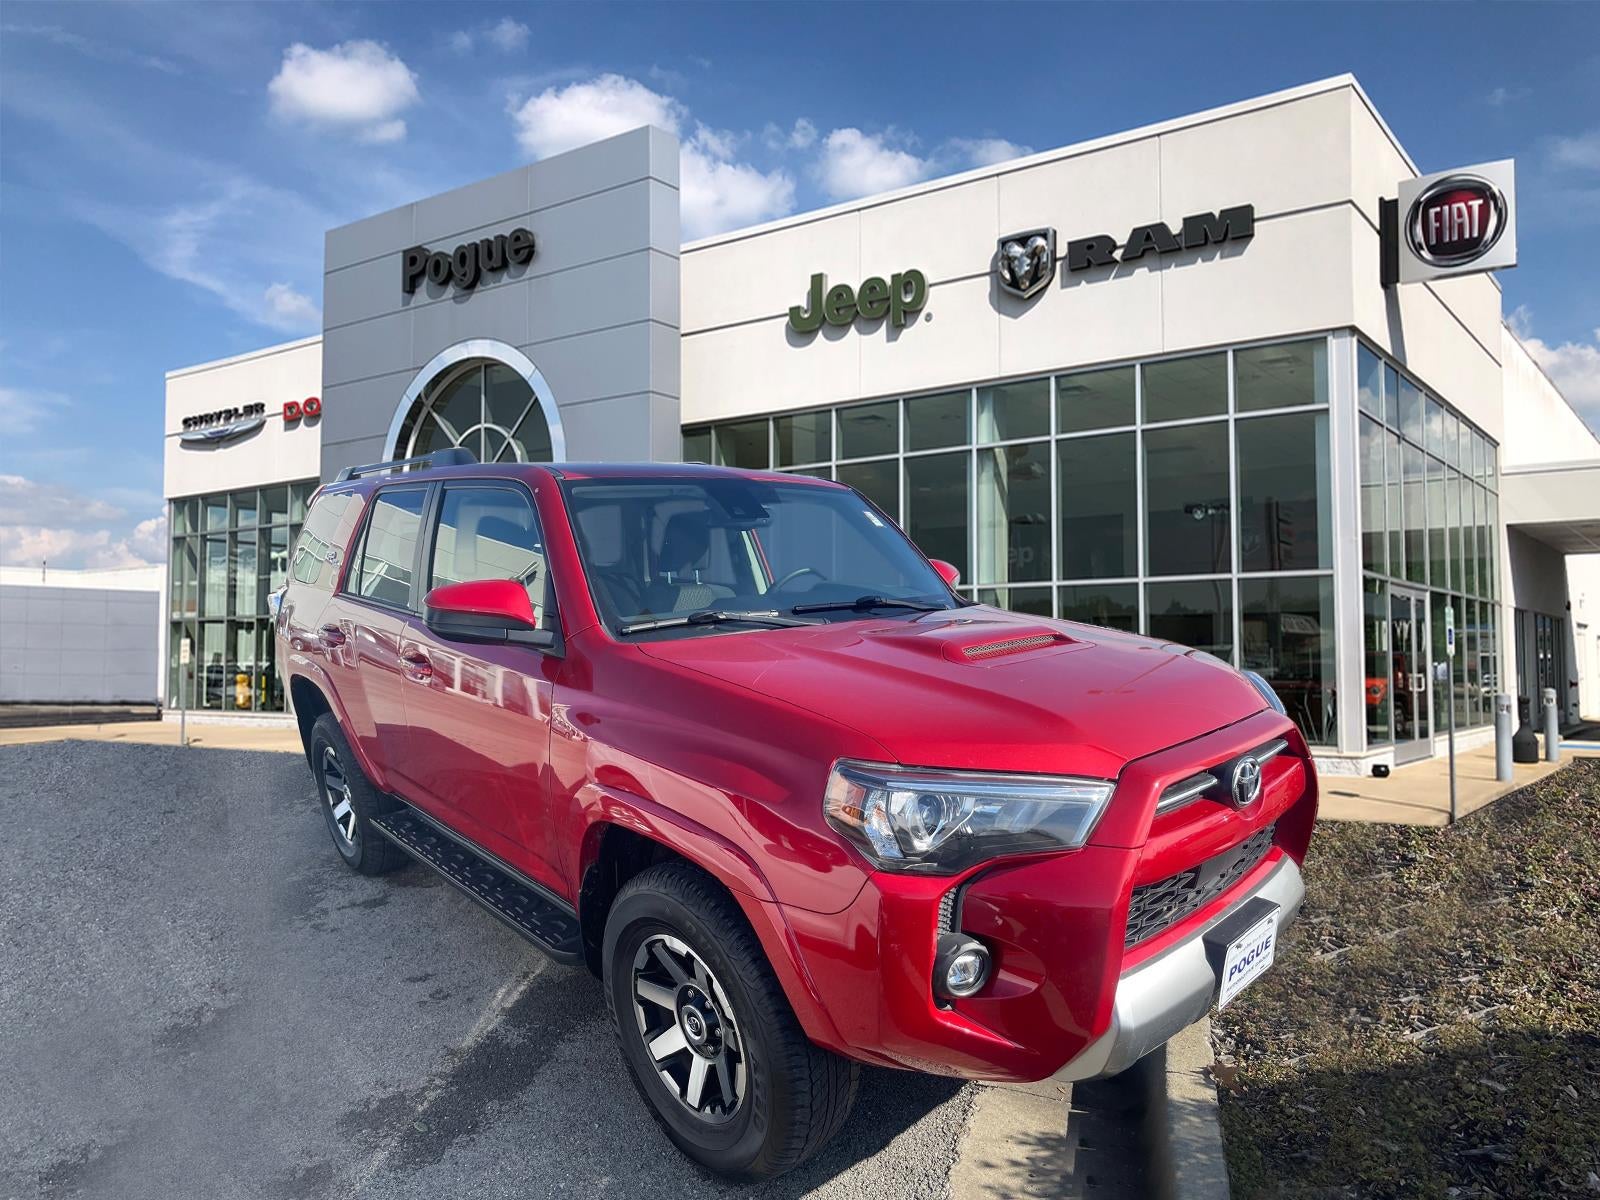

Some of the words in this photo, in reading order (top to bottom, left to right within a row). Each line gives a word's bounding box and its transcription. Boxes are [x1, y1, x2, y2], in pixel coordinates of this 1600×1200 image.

[1067, 203, 1255, 272] RAM
[1428, 199, 1484, 246] FIAT
[402, 228, 536, 294] Pogue
[788, 268, 928, 332] Jeep
[182, 402, 265, 428] CHRYSLER
[1228, 934, 1273, 982] POGUE
